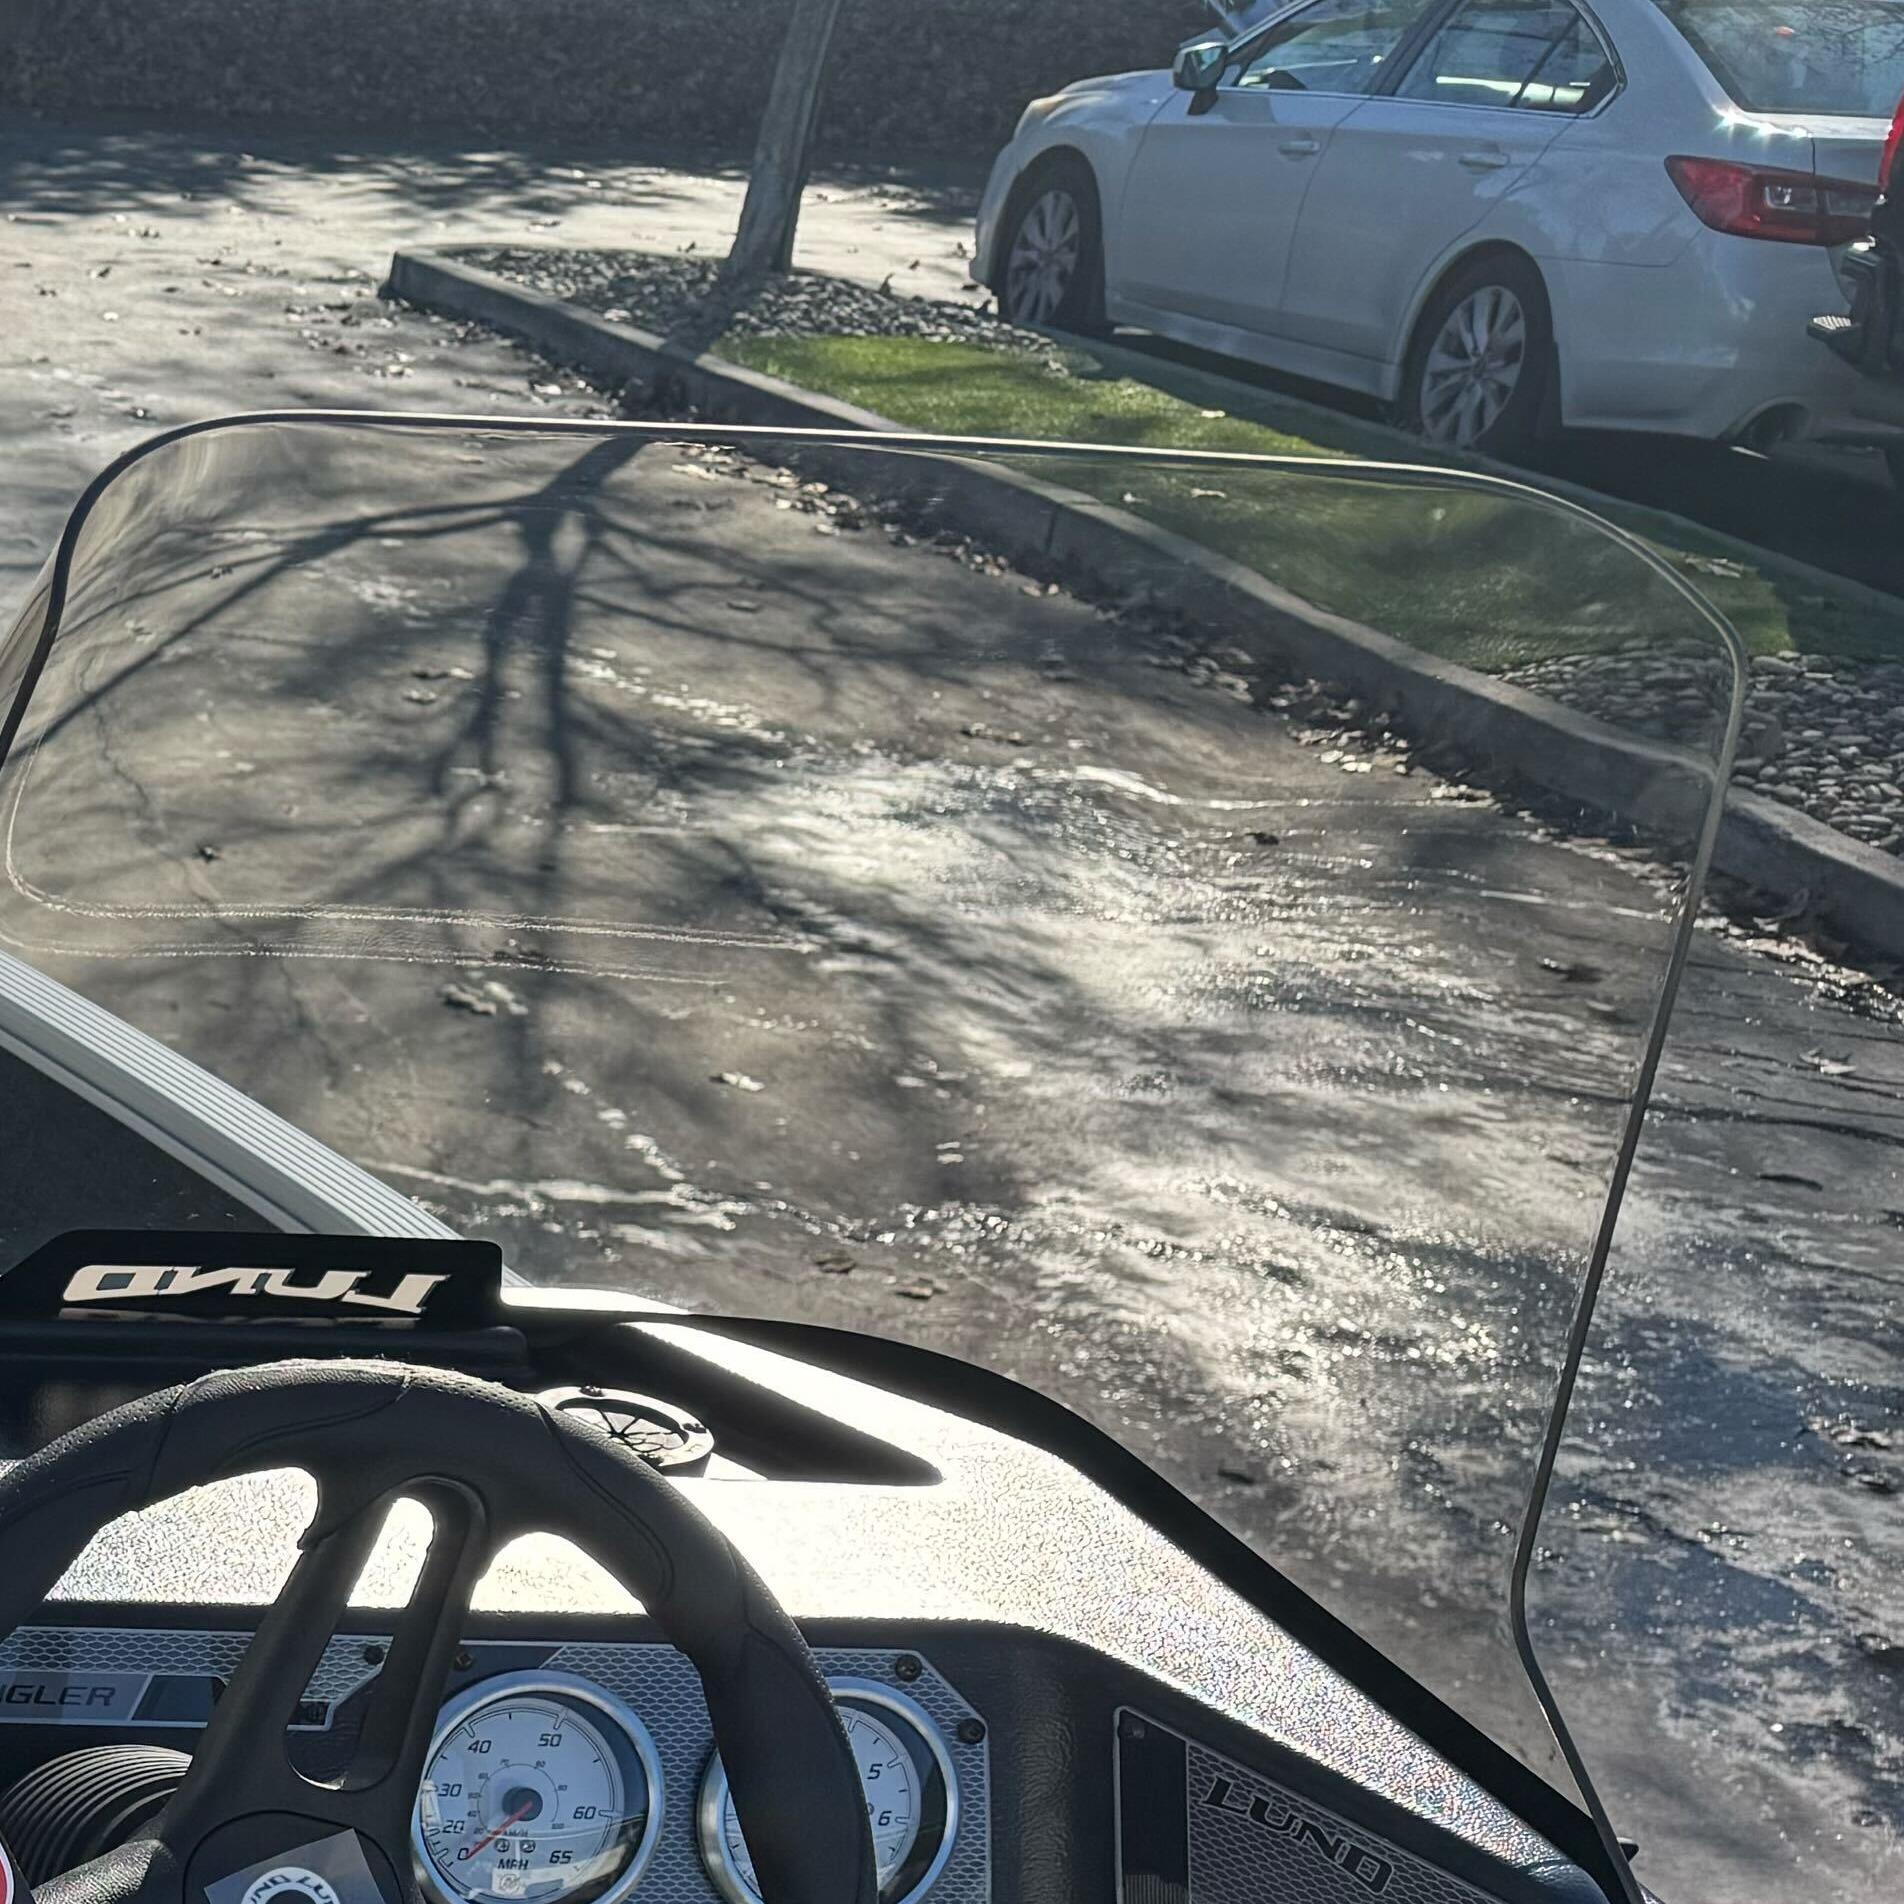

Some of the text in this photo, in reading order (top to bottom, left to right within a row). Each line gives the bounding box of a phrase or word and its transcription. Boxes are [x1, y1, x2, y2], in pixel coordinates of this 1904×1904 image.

[468, 1739, 492, 1754] 40
[538, 1733, 562, 1747] 50
[867, 1763, 883, 1780] 5
[438, 1783, 462, 1798] 30
[573, 1806, 597, 1820] 60
[878, 1810, 893, 1827] 6
[443, 1819, 465, 1834] 20
[1198, 1774, 1393, 1896] LUND
[457, 1847, 470, 1861] 0
[549, 1850, 573, 1864] 65
[497, 1858, 529, 1870] MPH
